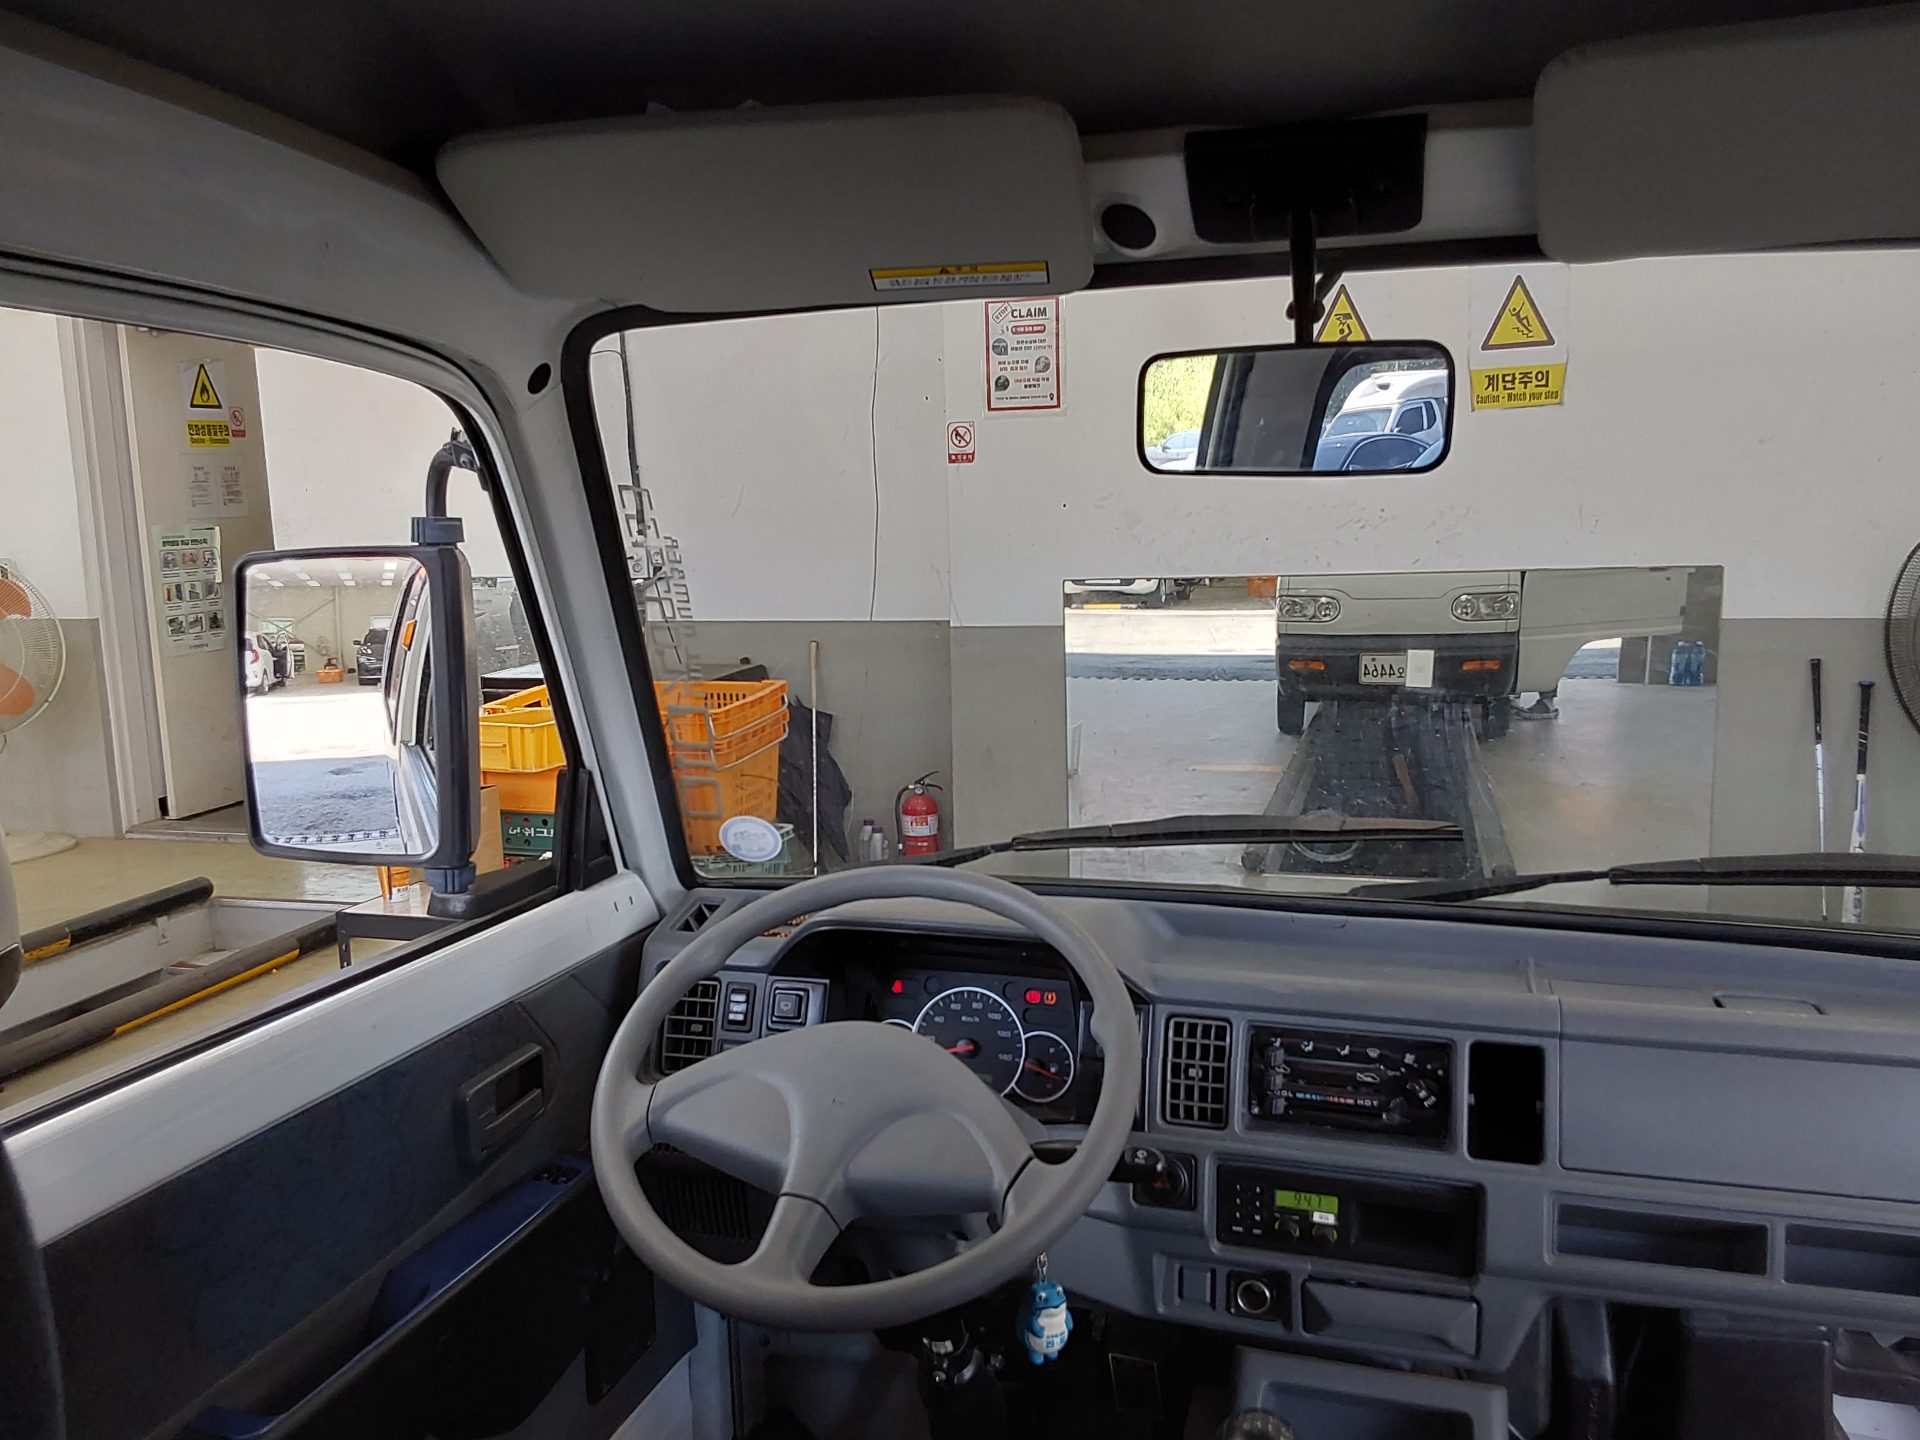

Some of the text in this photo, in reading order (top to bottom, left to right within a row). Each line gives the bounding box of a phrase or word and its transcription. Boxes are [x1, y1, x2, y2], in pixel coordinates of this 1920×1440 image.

[1011, 306, 1047, 318] CLAIM
[1484, 369, 1549, 392] 계단주의
[1475, 393, 1500, 405] Caution
[1529, 391, 1543, 402] your
[1544, 390, 1559, 400] step
[1357, 1099, 1379, 1107] HOT
